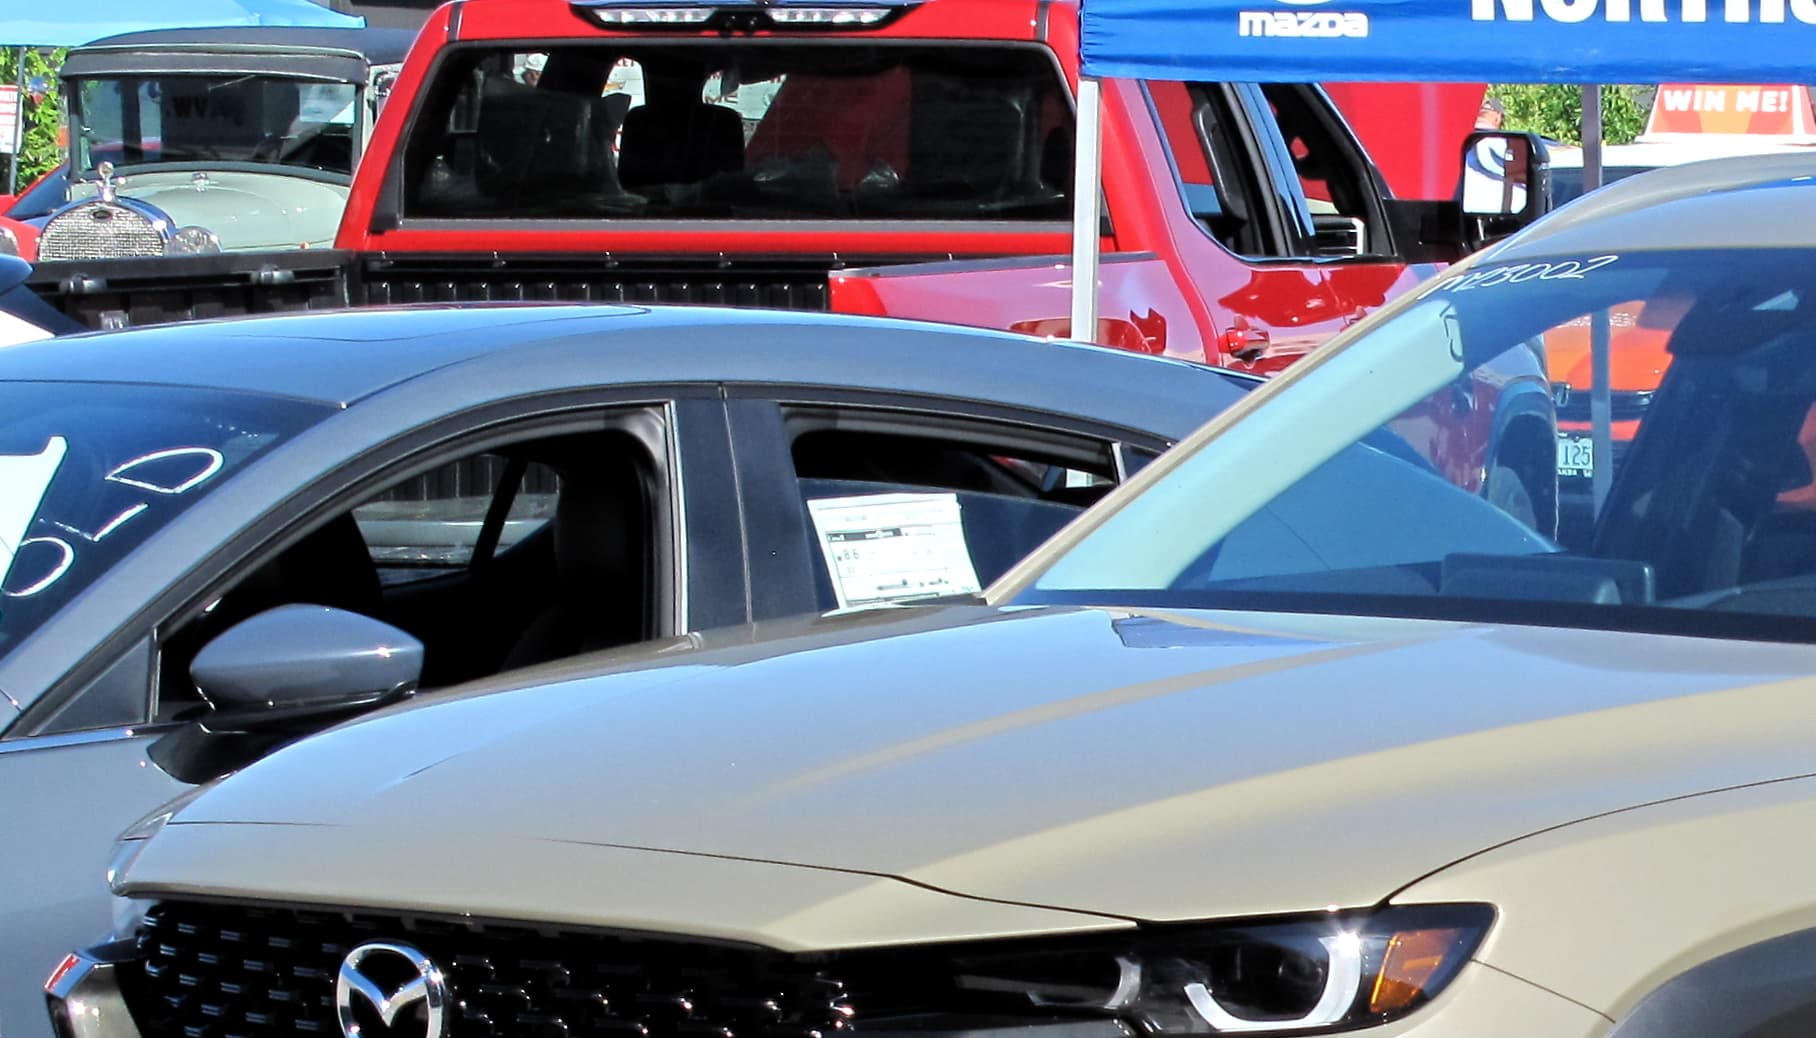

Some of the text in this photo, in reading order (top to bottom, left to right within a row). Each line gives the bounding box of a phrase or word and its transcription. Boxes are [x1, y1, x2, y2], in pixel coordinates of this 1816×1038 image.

[1238, 11, 1369, 38] mazda
[1663, 90, 1789, 113] WIN ME!
